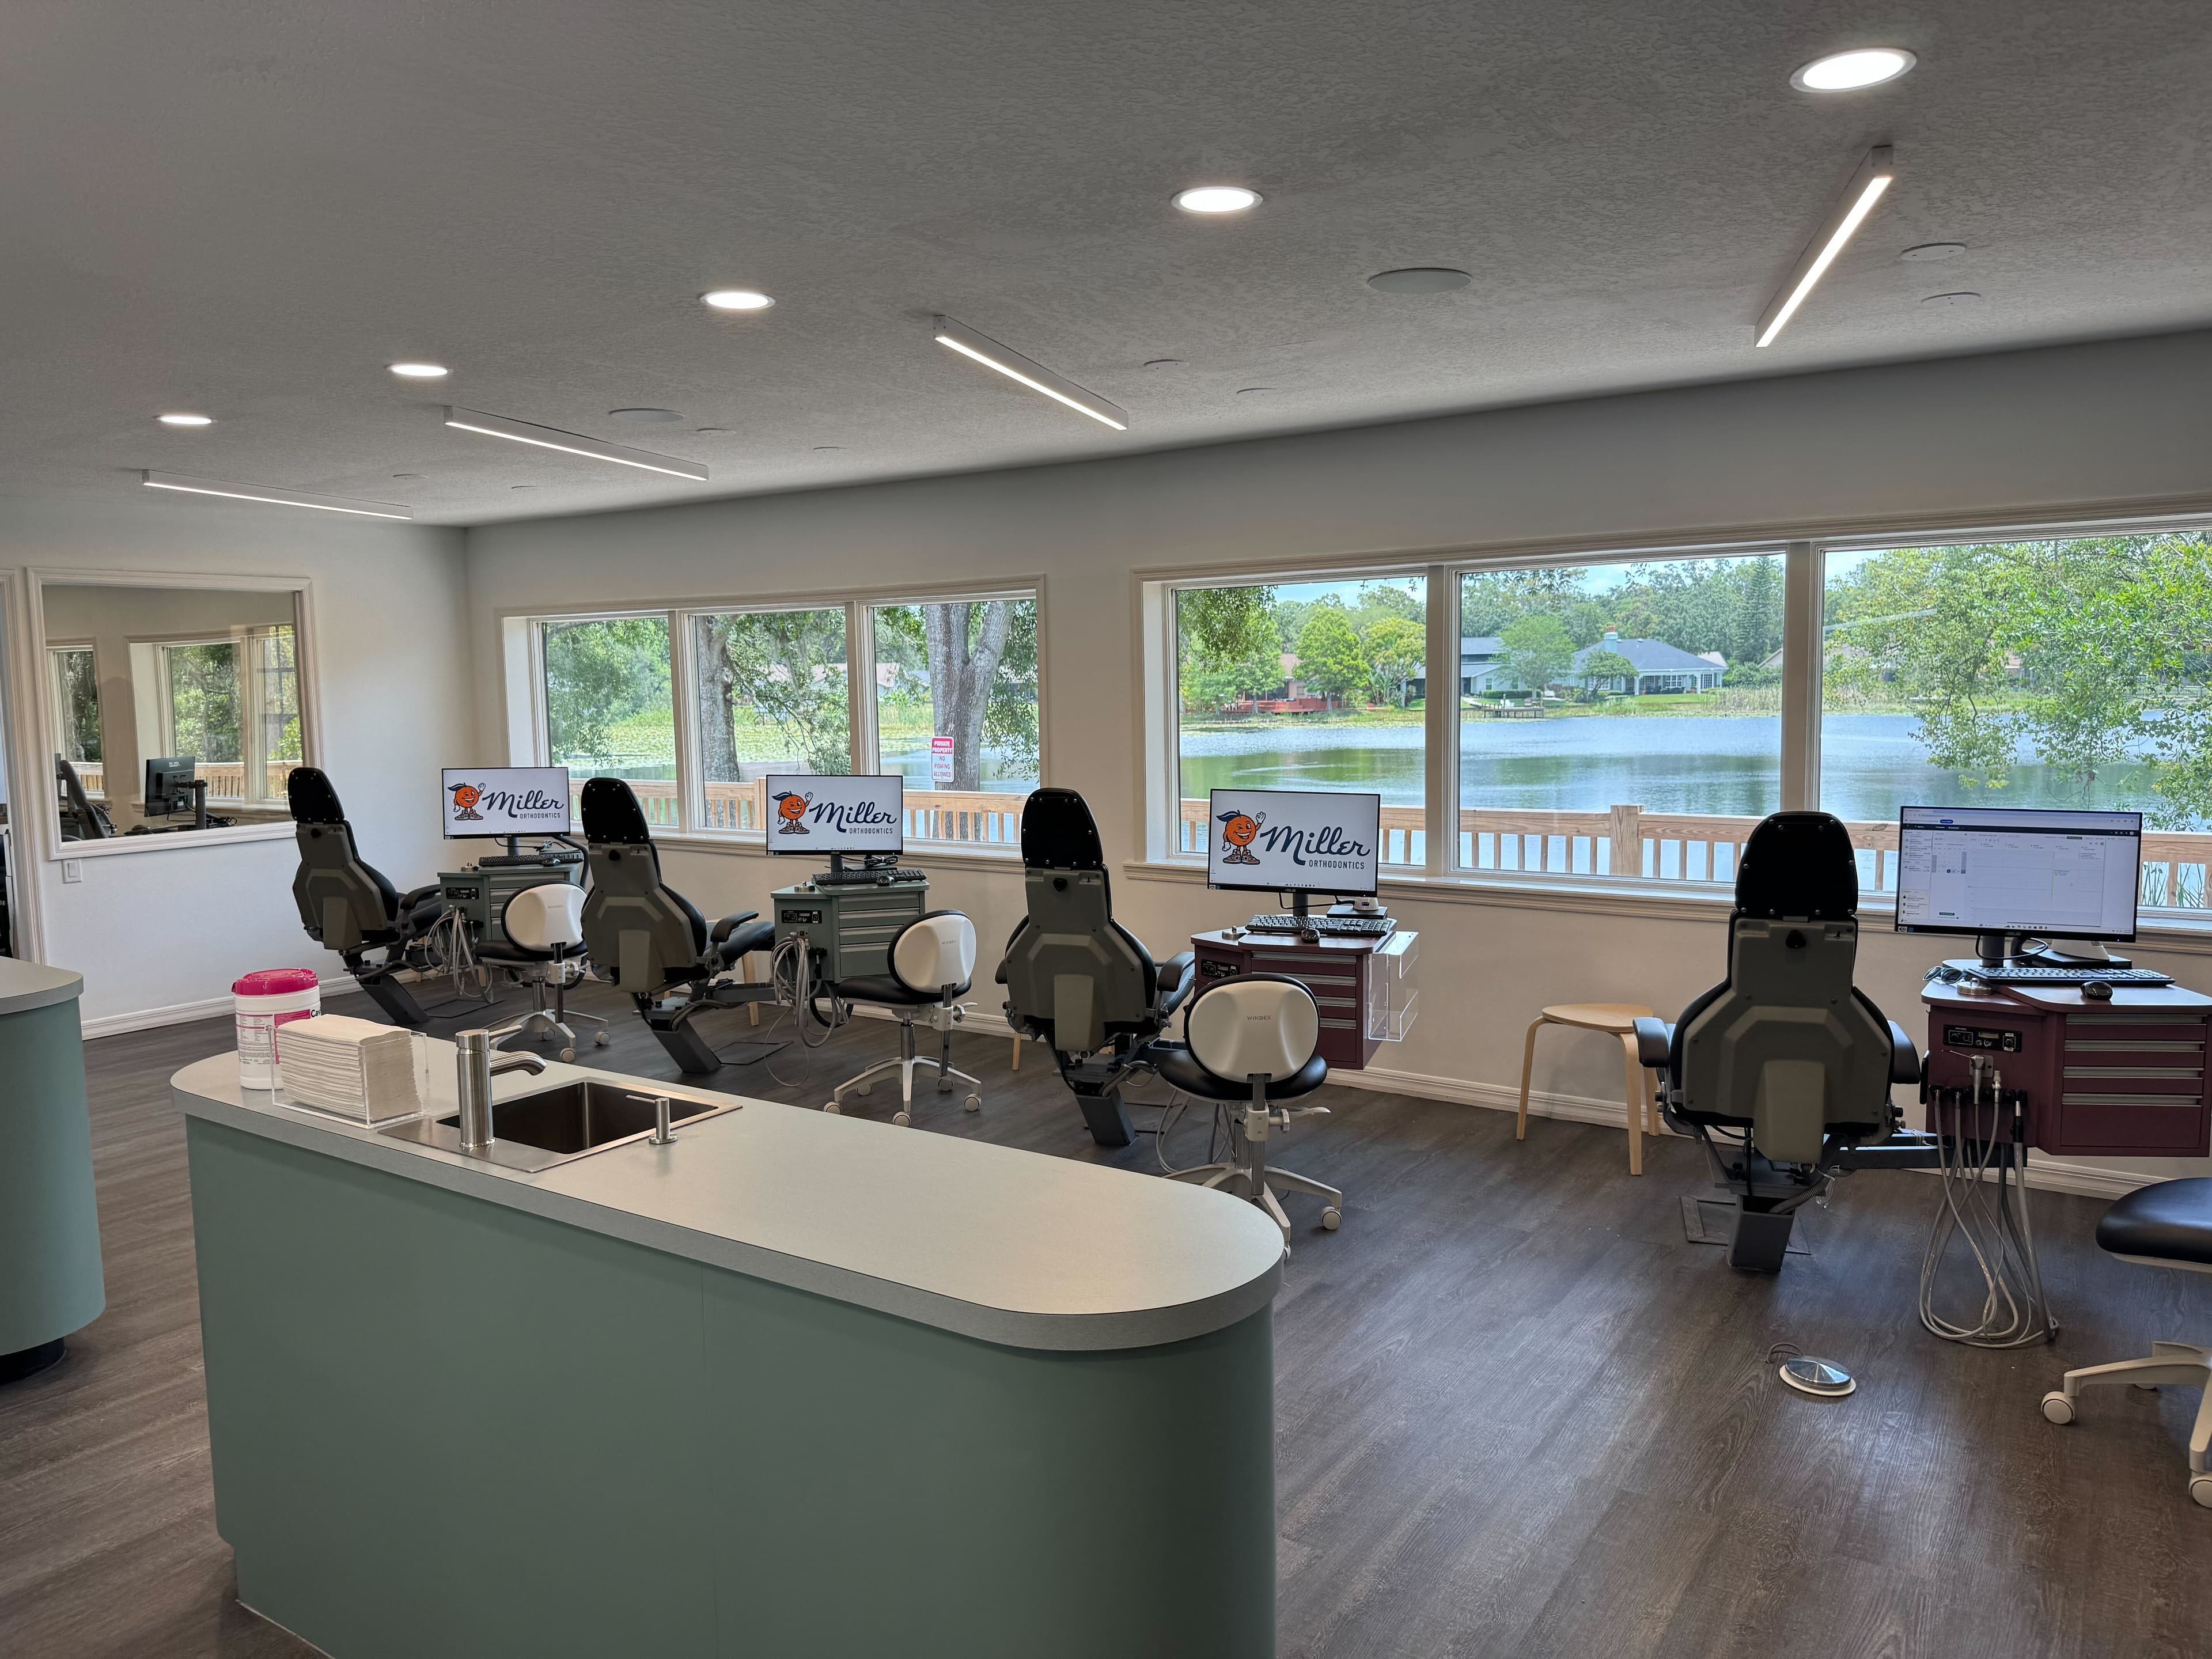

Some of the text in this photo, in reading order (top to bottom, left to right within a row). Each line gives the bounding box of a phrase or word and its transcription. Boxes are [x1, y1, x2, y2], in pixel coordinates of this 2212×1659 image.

[482, 790, 564, 818] Miller
[809, 801, 897, 833] Miller
[1260, 825, 1370, 865] Miller
[1309, 859, 1365, 869] ORTHODONTICS
